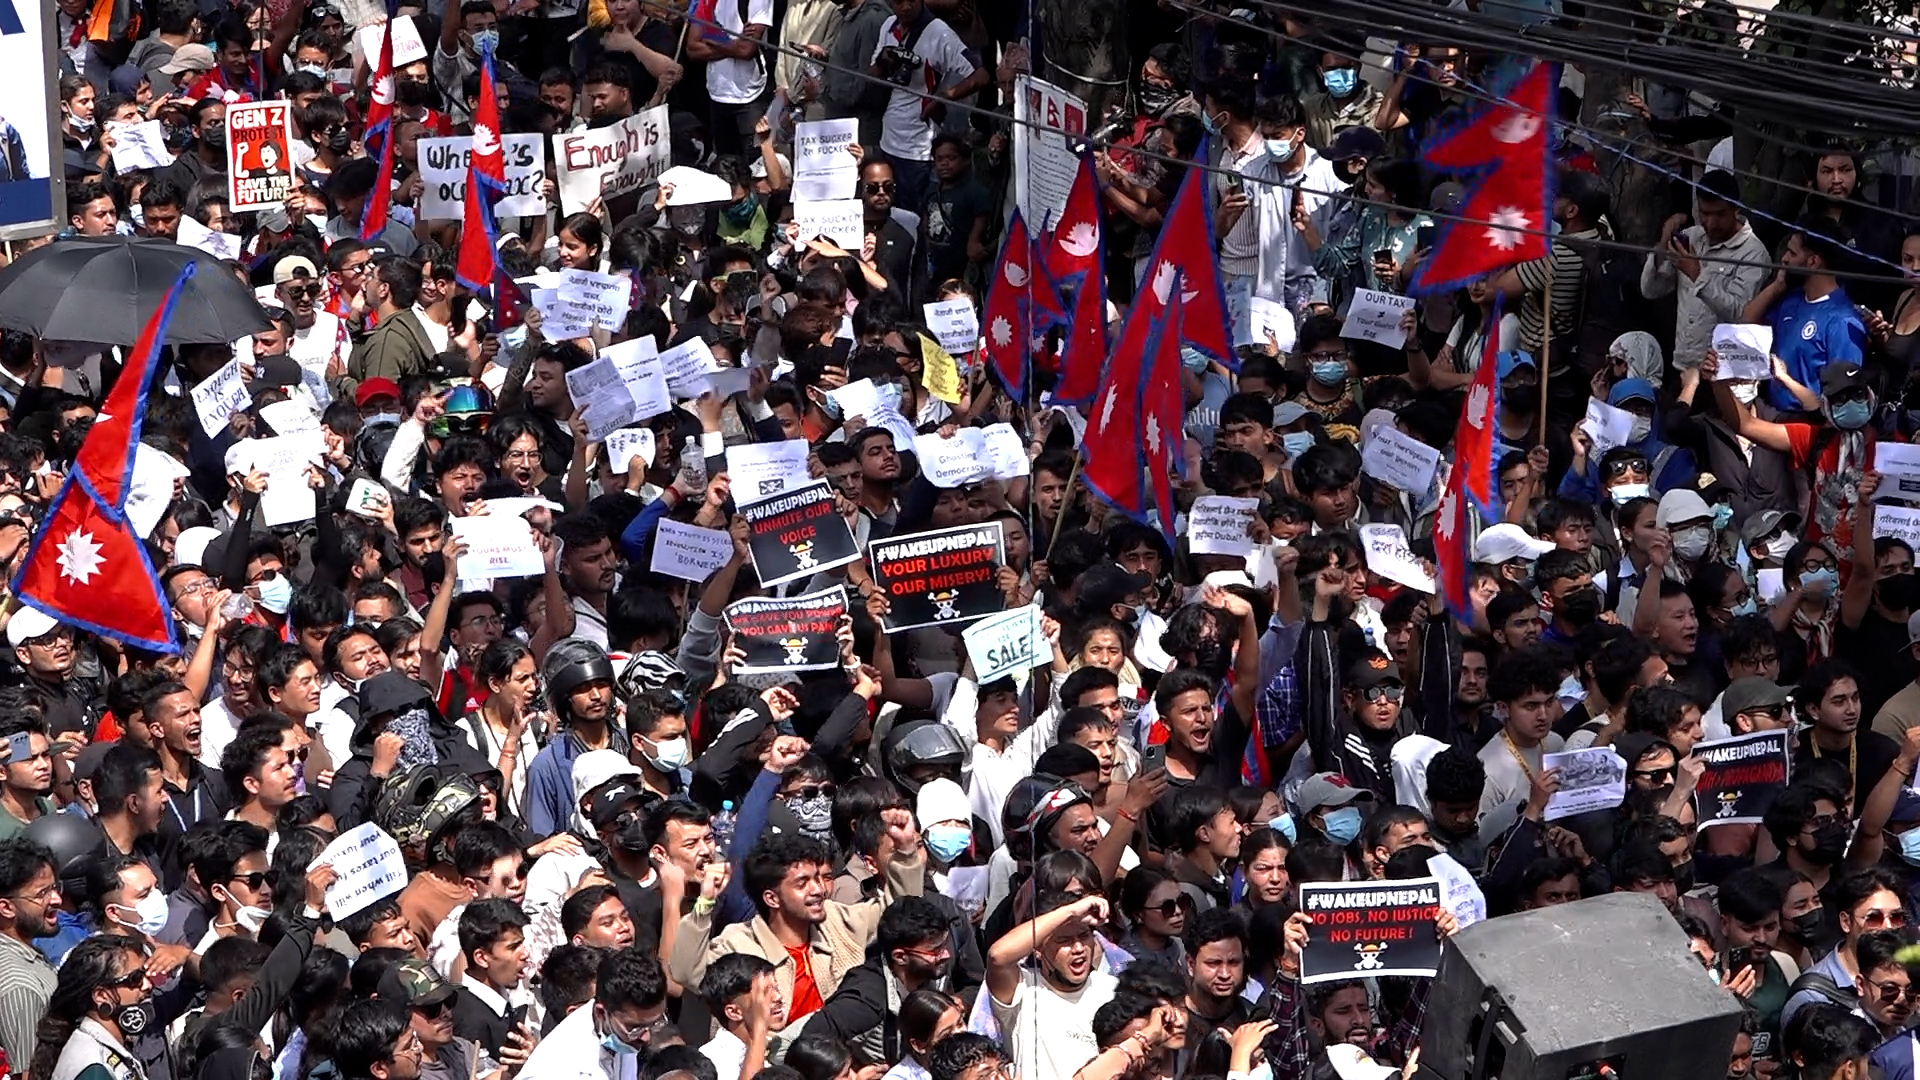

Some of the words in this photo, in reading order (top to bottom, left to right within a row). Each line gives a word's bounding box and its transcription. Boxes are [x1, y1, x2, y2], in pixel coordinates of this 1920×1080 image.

[231, 108, 267, 129] GEN
[270, 107, 283, 126] Z
[232, 126, 285, 143] PROTEST
[800, 136, 817, 147] TAX
[819, 132, 853, 144] SUCKER
[565, 133, 640, 172] Enough
[644, 126, 660, 146] is
[237, 176, 267, 190] SAVE
[268, 175, 290, 188] THE
[1365, 292, 1386, 305] OUR
[1388, 296, 1406, 308] TAX
[196, 361, 238, 404] ENOUGH
[203, 387, 246, 430] ENOUGH
[938, 452, 978, 464] Ghosting
[746, 487, 833, 522] #WAKEUPNEPAL
[754, 511, 804, 535] UNMUTE
[805, 502, 832, 518] OUR
[779, 525, 817, 545] VOICE
[876, 530, 997, 563] #WAKEUPNEPAL
[881, 558, 928, 577] YOUR
[929, 546, 996, 570] LUXURY
[891, 578, 927, 596] OUR
[929, 567, 991, 590] MISERY!
[729, 594, 842, 616] #WAKEUPNEPAL
[783, 610, 804, 621] YOU
[741, 626, 765, 636] YOU
[767, 623, 796, 634] GAVE
[986, 633, 1031, 670] SALE
[379, 847, 396, 862] our
[350, 856, 379, 875] taxes
[354, 876, 384, 897] when
[1307, 888, 1438, 910] #WAKEUPNEPAL
[1329, 910, 1364, 925] JOBS,
[1367, 909, 1388, 923] NO
[1392, 906, 1440, 922] JUSTICE
[1330, 929, 1352, 942] NO
[1354, 926, 1406, 941] FUTURE
